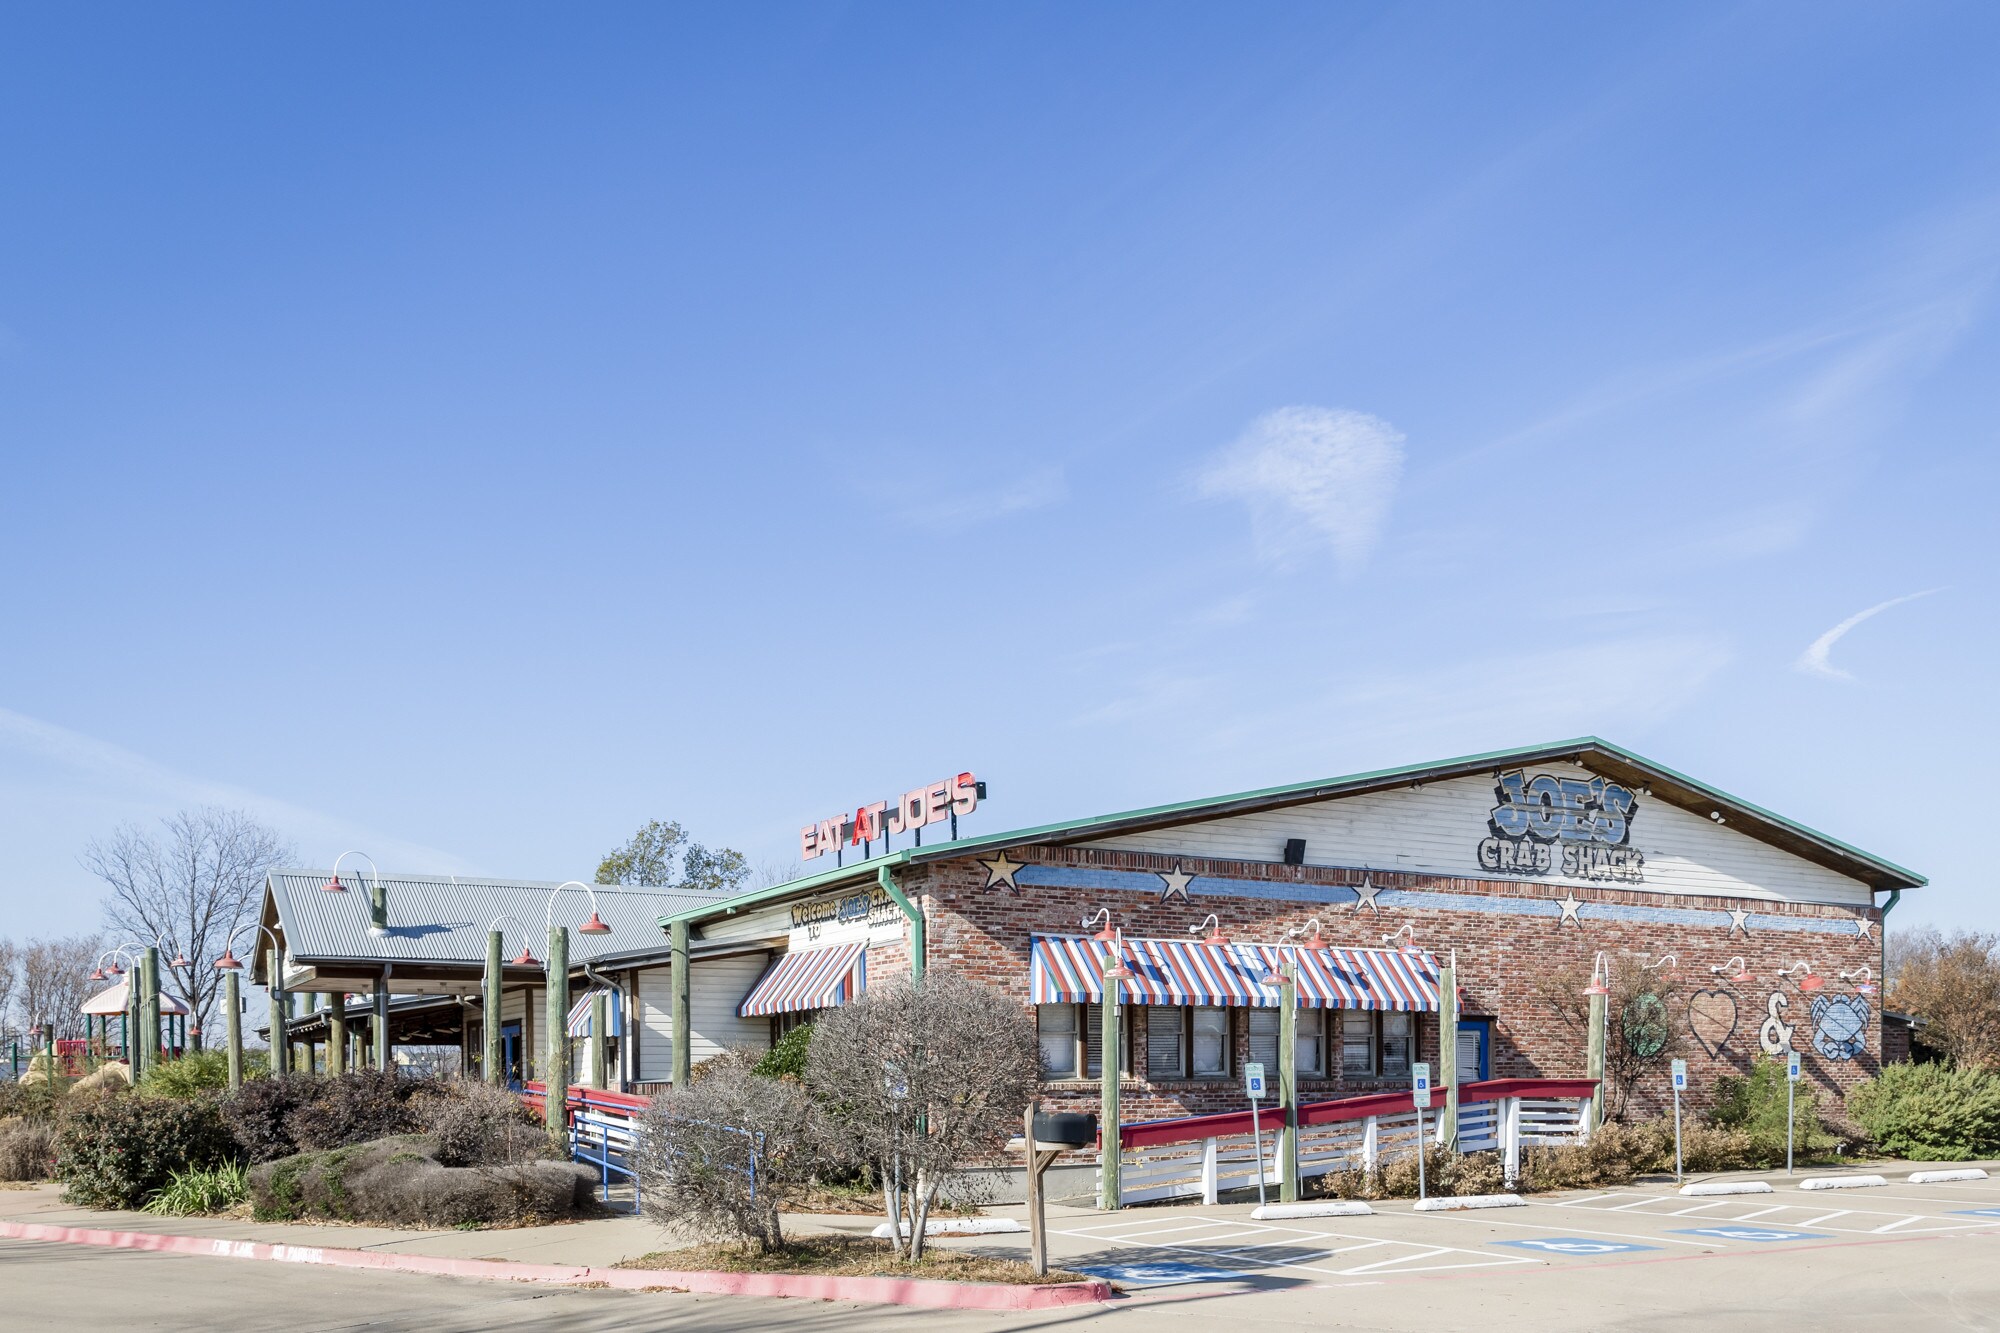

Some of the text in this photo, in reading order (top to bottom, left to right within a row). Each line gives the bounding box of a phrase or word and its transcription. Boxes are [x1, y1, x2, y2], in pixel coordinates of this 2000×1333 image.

[801, 772, 976, 861] EAT AT JOE'S
[1490, 770, 1636, 844] JOE'S
[1478, 837, 1645, 884] CRAB SHACK
[791, 900, 836, 927] Welcome
[870, 887, 894, 907] CRA
[808, 922, 821, 939] TO
[1760, 990, 1795, 1054] &
[271, 1245, 285, 1259] NO
[287, 1246, 323, 1262] PARKING
